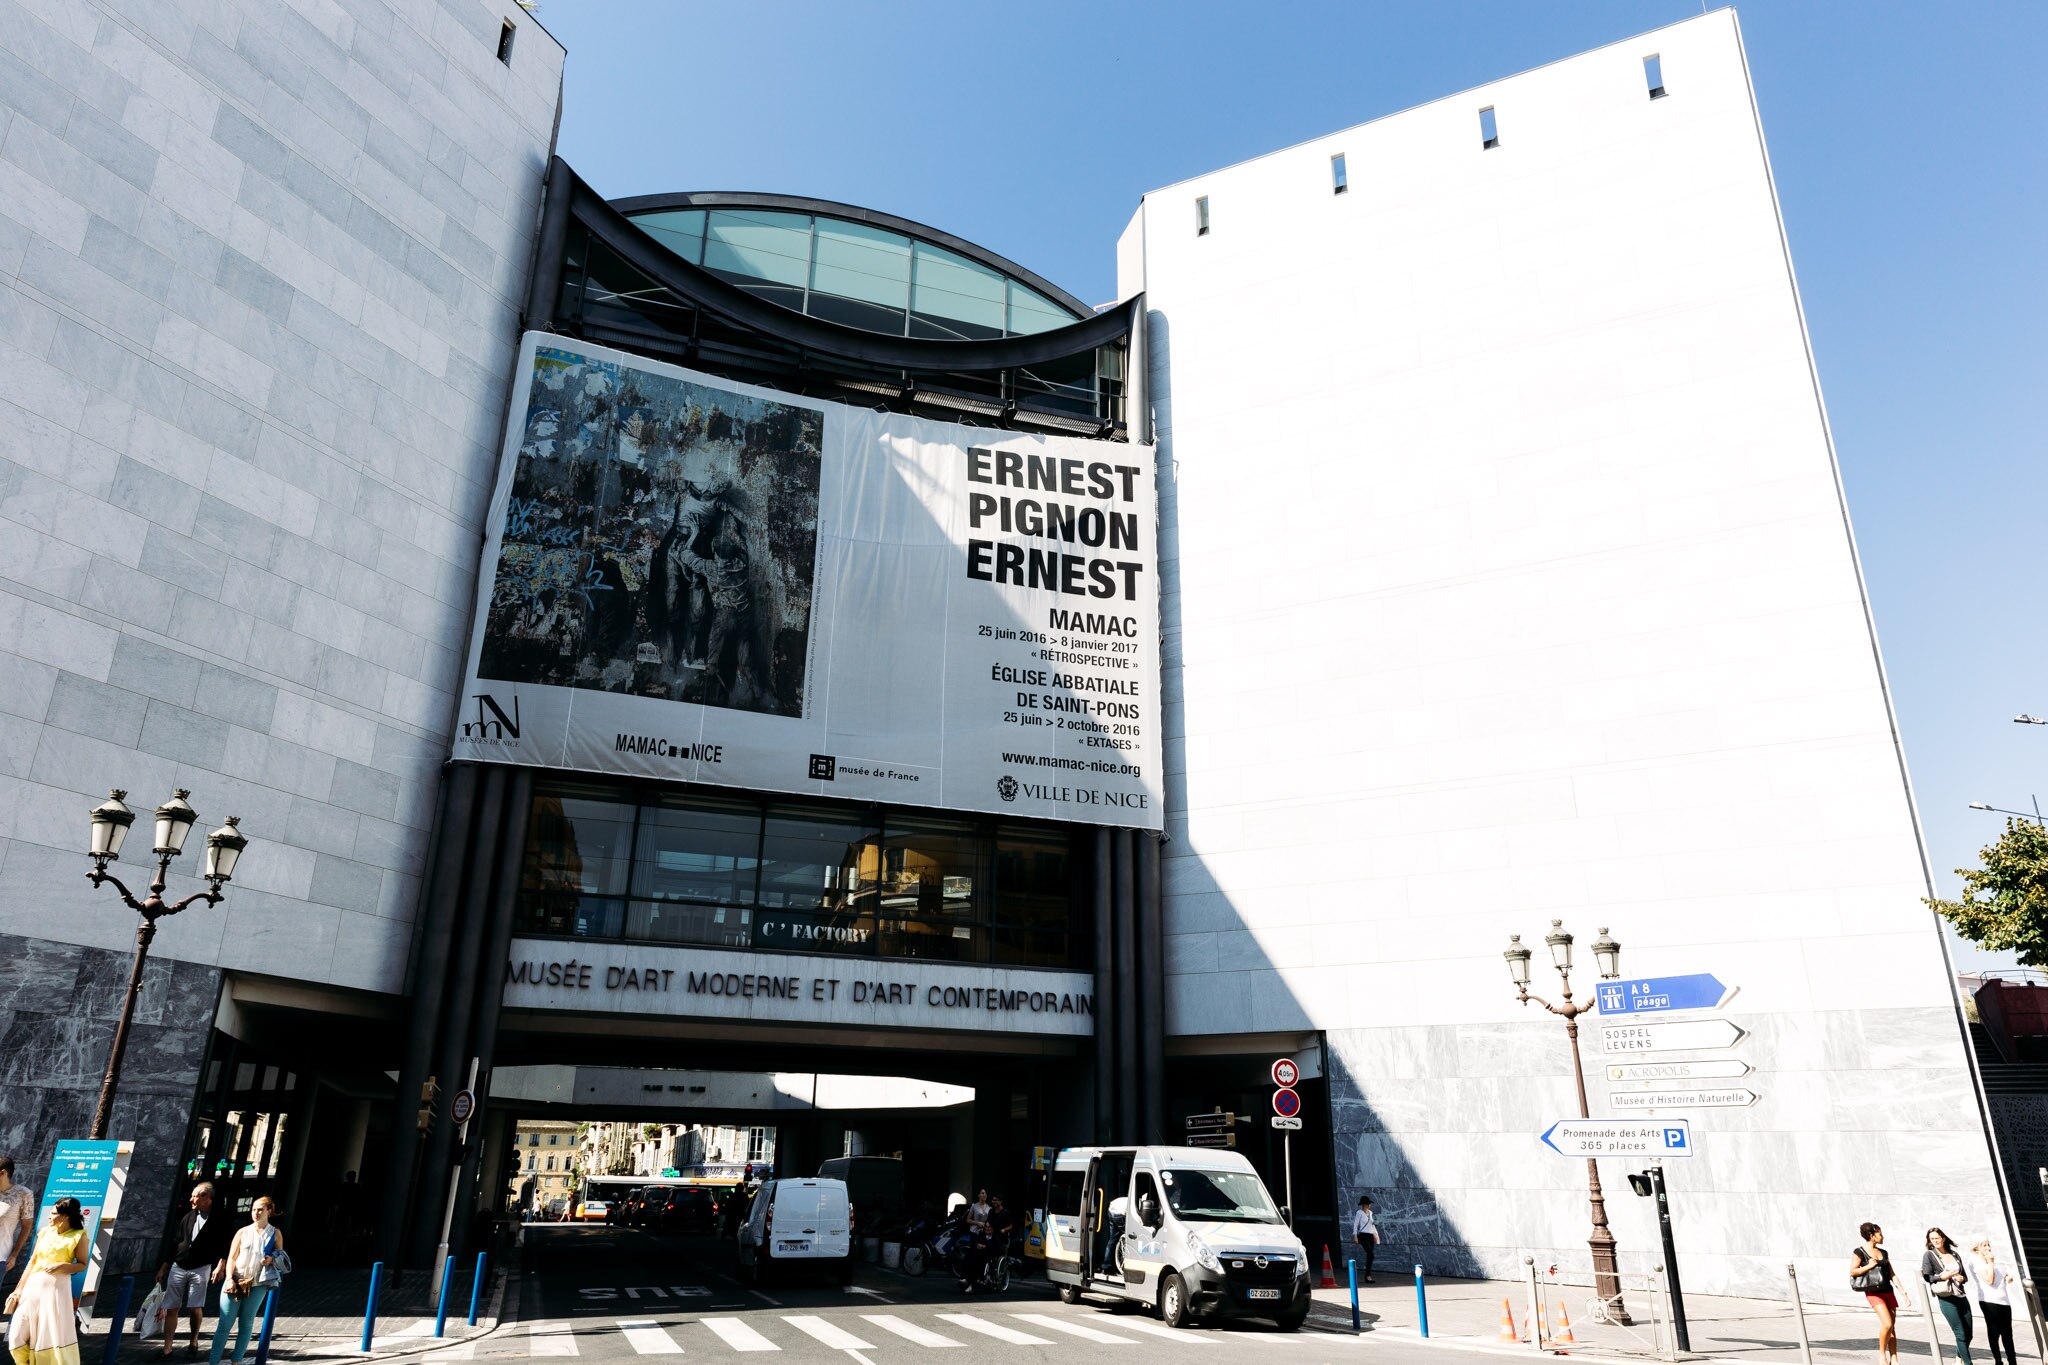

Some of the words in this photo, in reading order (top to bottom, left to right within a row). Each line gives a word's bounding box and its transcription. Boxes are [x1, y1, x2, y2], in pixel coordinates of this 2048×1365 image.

[967, 447, 1140, 502] ERNEST
[969, 493, 1138, 551] PIGNON
[967, 538, 1143, 601] ERNEST
[1049, 608, 1137, 638] MAMAC
[978, 625, 993, 637] 25
[995, 627, 1017, 640] juin
[1019, 631, 1046, 644] 2016
[1061, 636, 1068, 646] 8
[1071, 638, 1108, 651] janvier
[1111, 642, 1138, 654] 2017
[1040, 649, 1129, 669] RÉTROSPECTIVE
[992, 663, 1047, 686] ÉGLISE
[1052, 673, 1139, 696] ABBATIALE
[1017, 693, 1038, 708] DE
[1043, 694, 1139, 719] SAINT-PONS
[1004, 712, 1017, 722] 25
[1021, 713, 1042, 726] juin
[1057, 718, 1064, 728] 2
[1067, 719, 1110, 733] octobre
[1113, 724, 1140, 736] 2016
[501, 739, 520, 748] NICE
[616, 734, 667, 756] MAMAC
[691, 743, 723, 763] NICE
[1087, 737, 1132, 750] EXTASES
[839, 766, 870, 776] musée
[873, 768, 884, 778] de
[888, 771, 920, 782] France
[1002, 753, 1141, 777] www.mamac-nice.org
[1023, 783, 1070, 802] VILLE
[1076, 789, 1099, 804] DE
[1105, 793, 1148, 809] NICE
[792, 924, 870, 943] FACTORY
[507, 959, 593, 988] MUSÉE
[606, 967, 674, 992] D'ART
[688, 971, 800, 1000] MODERNE
[813, 979, 840, 1001] ET
[854, 981, 916, 1004] D'ART
[928, 985, 1094, 1015] CONTEMPORAIN
[1632, 984, 1638, 994] A
[1643, 984, 1650, 994] 8
[1637, 996, 1667, 1008] péage
[1606, 1029, 1651, 1039] SOSPEL
[1606, 1040, 1652, 1050] LEVENS
[1628, 1066, 1690, 1077] ACROPOLIS
[1649, 1094, 1694, 1104] d'Histoire
[1699, 1093, 1744, 1103] Naturelle
[1563, 1129, 1616, 1138] Promenade
[1619, 1129, 1636, 1137] des
[1640, 1129, 1660, 1137] Arts
[1669, 1131, 1681, 1146] P
[1581, 1141, 1602, 1150] 365
[1609, 1141, 1646, 1152] places
[578, 1286, 714, 1300] BUS
